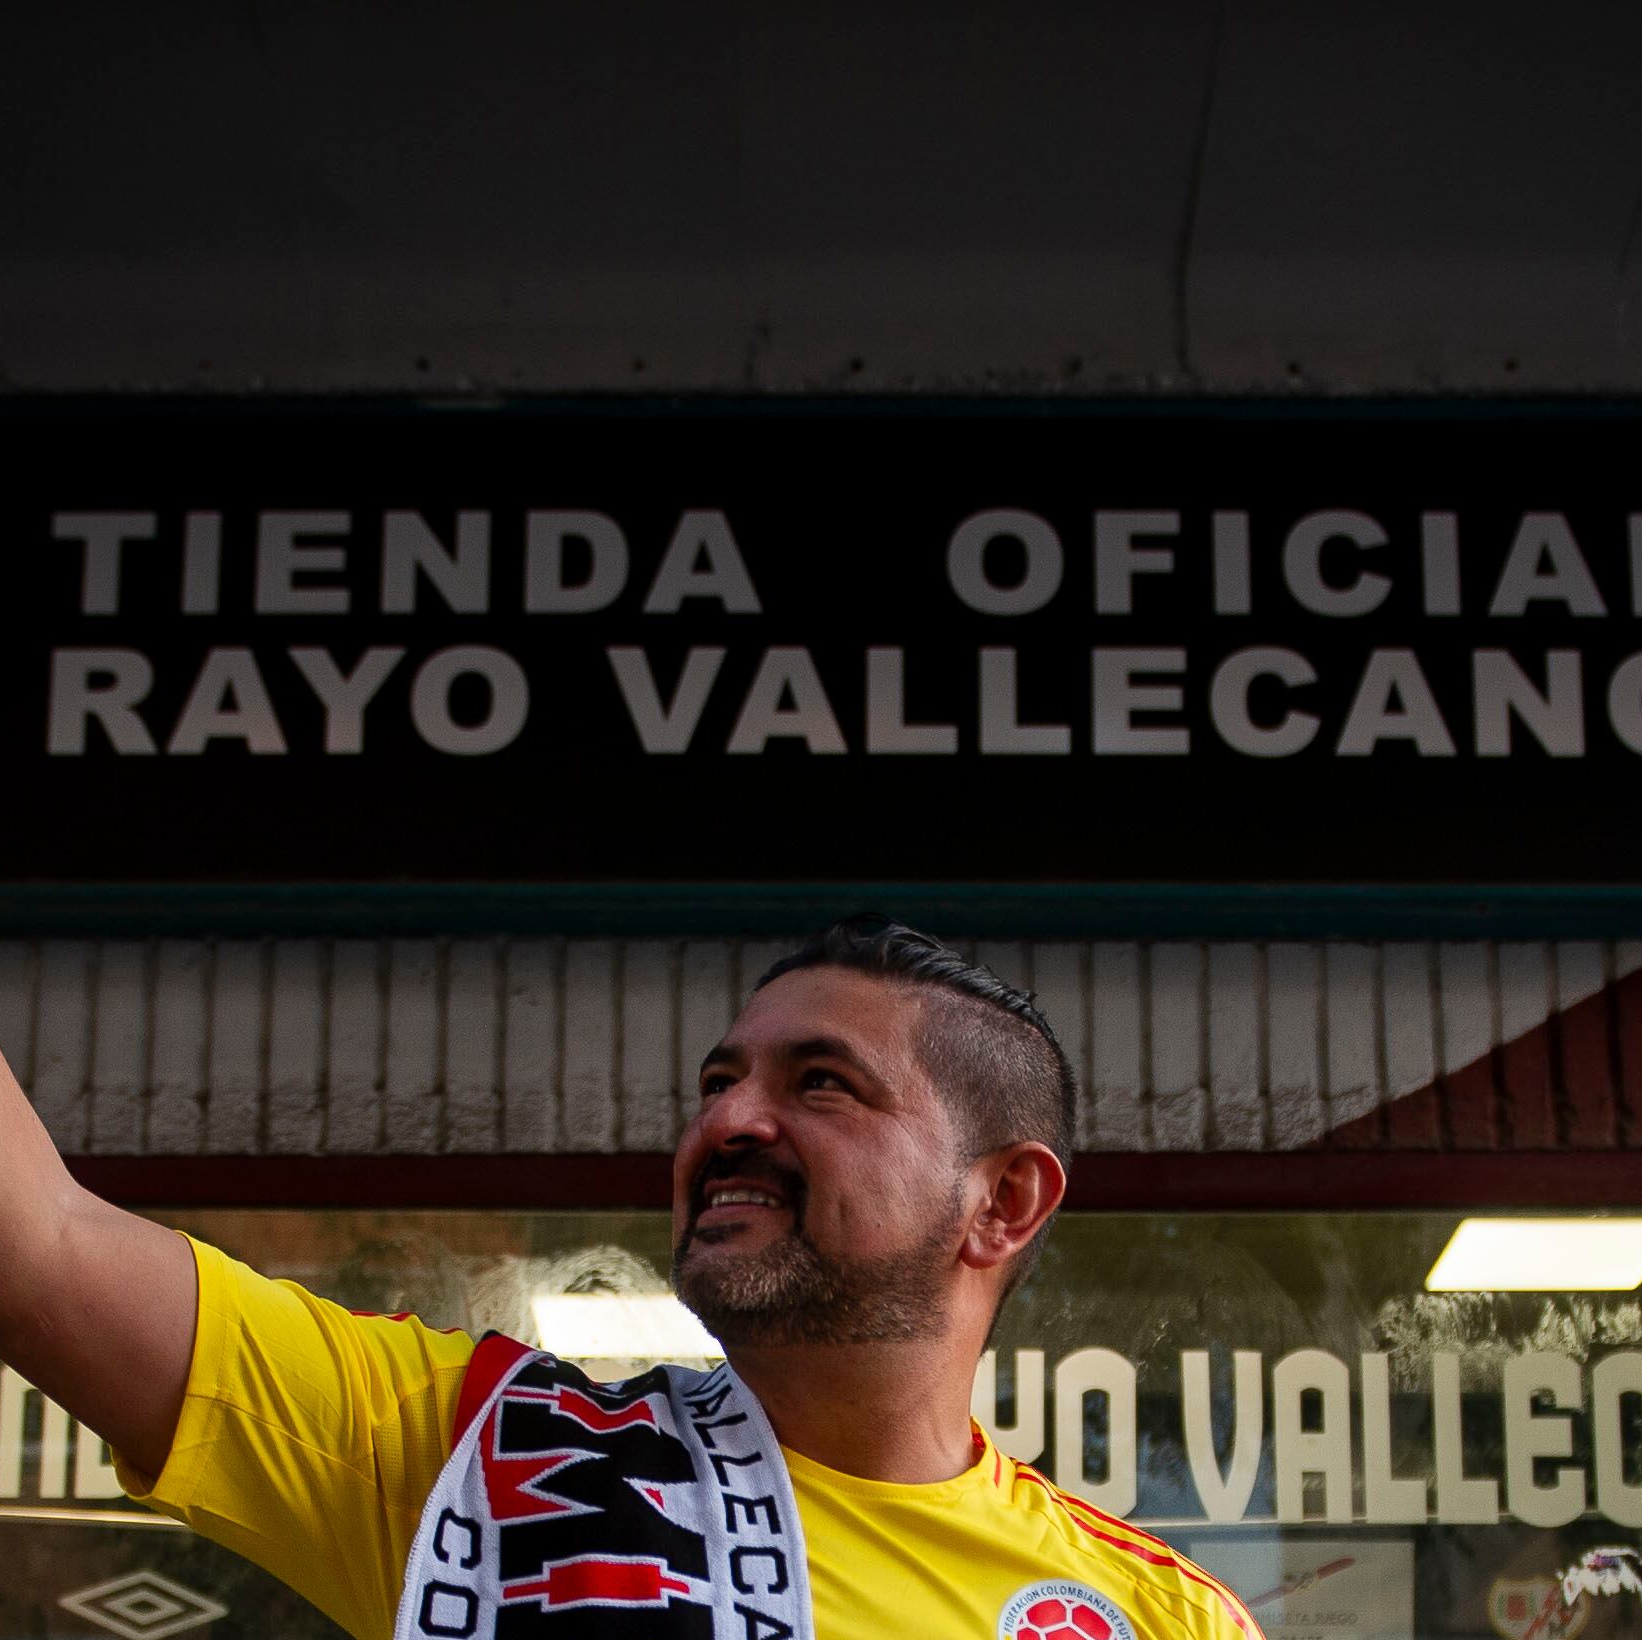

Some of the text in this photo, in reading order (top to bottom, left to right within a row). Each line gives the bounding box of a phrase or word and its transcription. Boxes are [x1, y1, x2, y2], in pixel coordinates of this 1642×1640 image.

[50, 509, 765, 617] TIENDA
[45, 643, 531, 757] RAYO
[970, 1345, 1137, 1519] YO
[1041, 1585, 1107, 1612] COLOMBIANA
